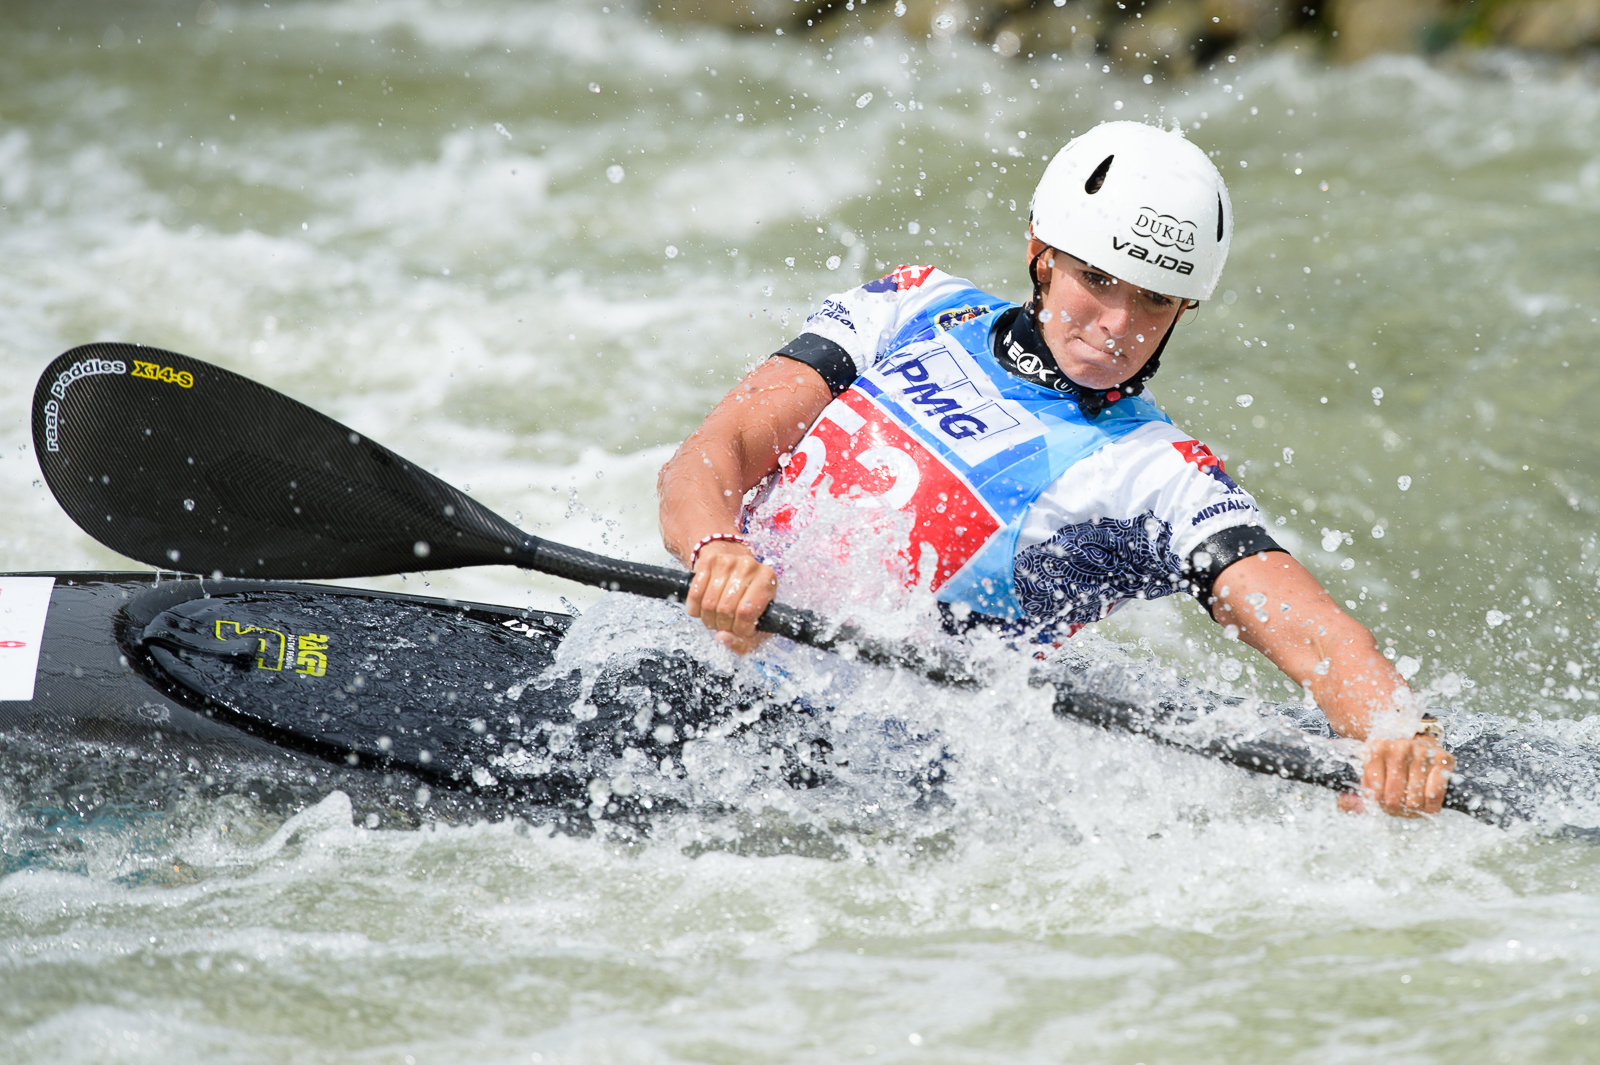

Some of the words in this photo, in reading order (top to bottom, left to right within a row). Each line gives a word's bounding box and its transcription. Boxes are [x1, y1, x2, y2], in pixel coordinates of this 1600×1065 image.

[1135, 214, 1195, 246] DUKLA
[51, 358, 127, 400] paddles
[131, 360, 194, 389] X14-S
[44, 400, 59, 451] raab
[1192, 498, 1260, 526] MINTÁLO
